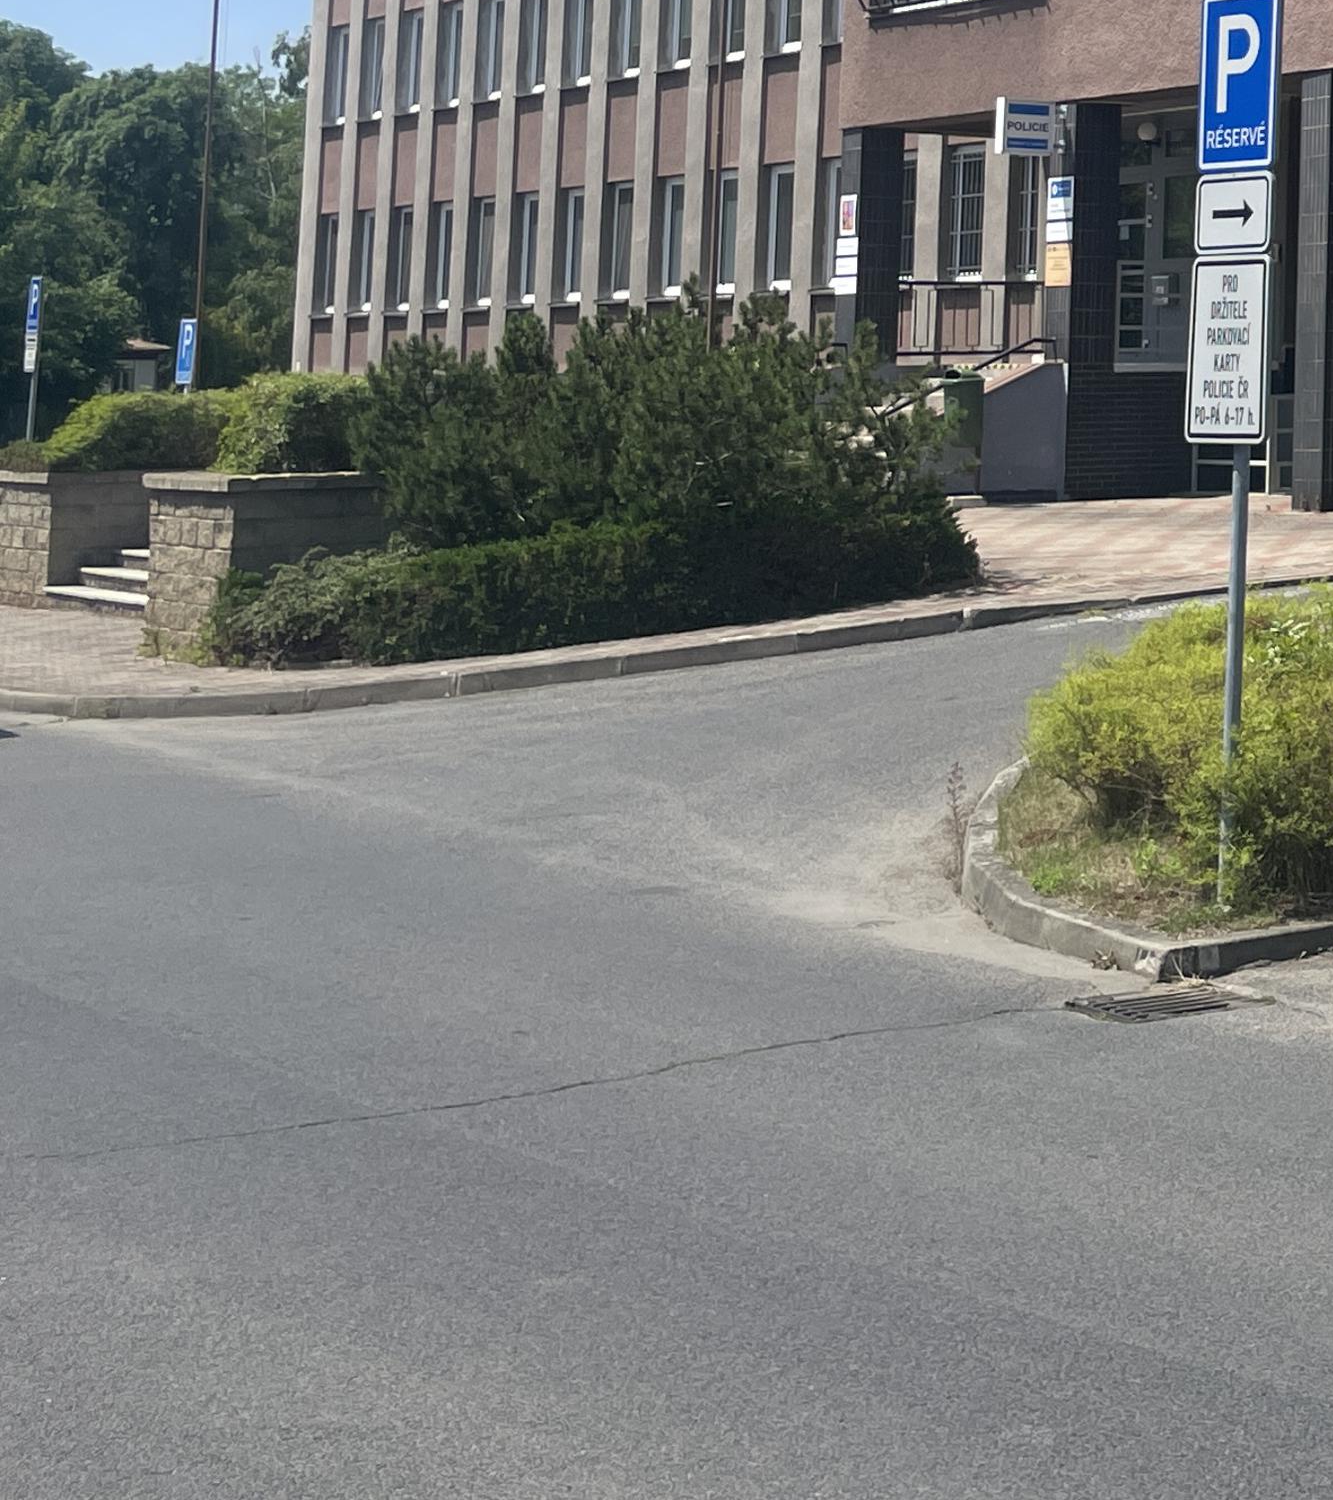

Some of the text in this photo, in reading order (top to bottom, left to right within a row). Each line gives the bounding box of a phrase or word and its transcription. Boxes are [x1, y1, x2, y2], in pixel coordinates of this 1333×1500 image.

[1216, 13, 1260, 113] P
[1007, 121, 1049, 132] POLICIE
[1206, 120, 1266, 149] RÉSERVÉ
[1222, 274, 1238, 293] PRO
[30, 283, 39, 316] P
[1211, 298, 1248, 320] DRŽITELE
[182, 324, 193, 359] P
[1207, 323, 1251, 346] PARKOVACÍ
[1214, 353, 1240, 372] KARTY
[1203, 376, 1249, 399] POLICIE ČR
[1194, 402, 1221, 425] PO-PÁ
[1225, 407, 1244, 426] 6-17
